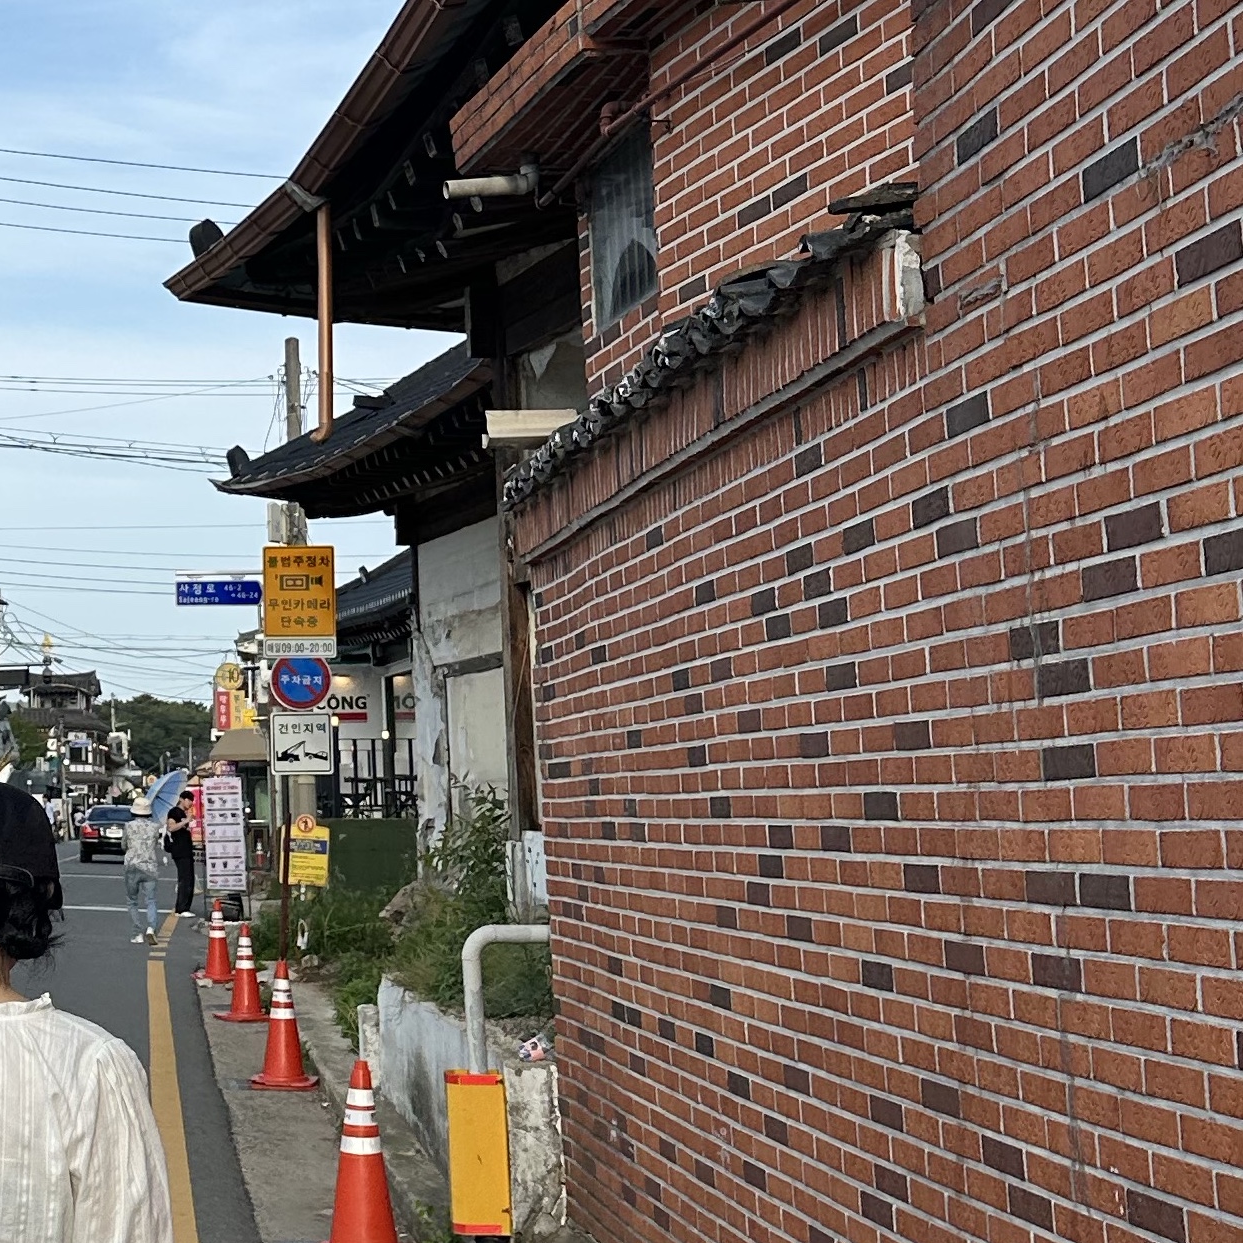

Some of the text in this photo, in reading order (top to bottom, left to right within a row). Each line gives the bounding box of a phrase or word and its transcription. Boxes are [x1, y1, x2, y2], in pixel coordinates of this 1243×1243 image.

[268, 555, 330, 568] 불법주정차
[178, 583, 216, 595] 사정로
[268, 598, 331, 611] 무인카메라
[280, 615, 319, 629] 단속중
[280, 674, 323, 686] 주차금지
[278, 722, 327, 735] 견인지역
